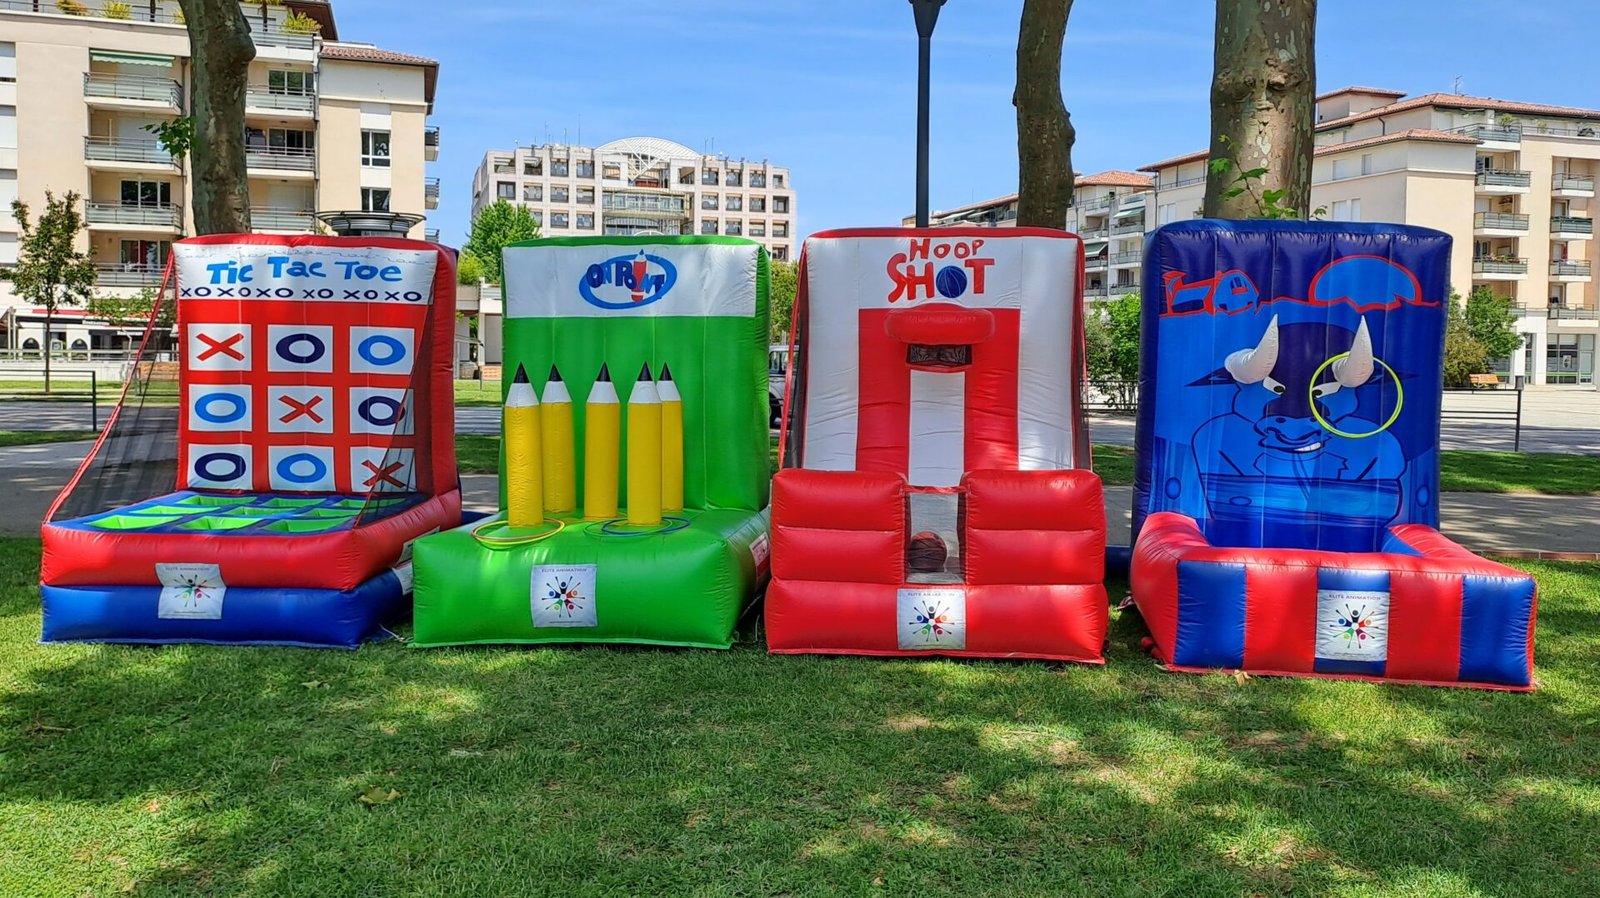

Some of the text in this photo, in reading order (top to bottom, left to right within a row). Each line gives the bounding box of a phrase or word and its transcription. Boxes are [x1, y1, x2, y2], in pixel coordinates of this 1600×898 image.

[909, 239, 984, 261] HOOP
[206, 256, 403, 284] Tic Tac Toe
[586, 263, 612, 288] ON
